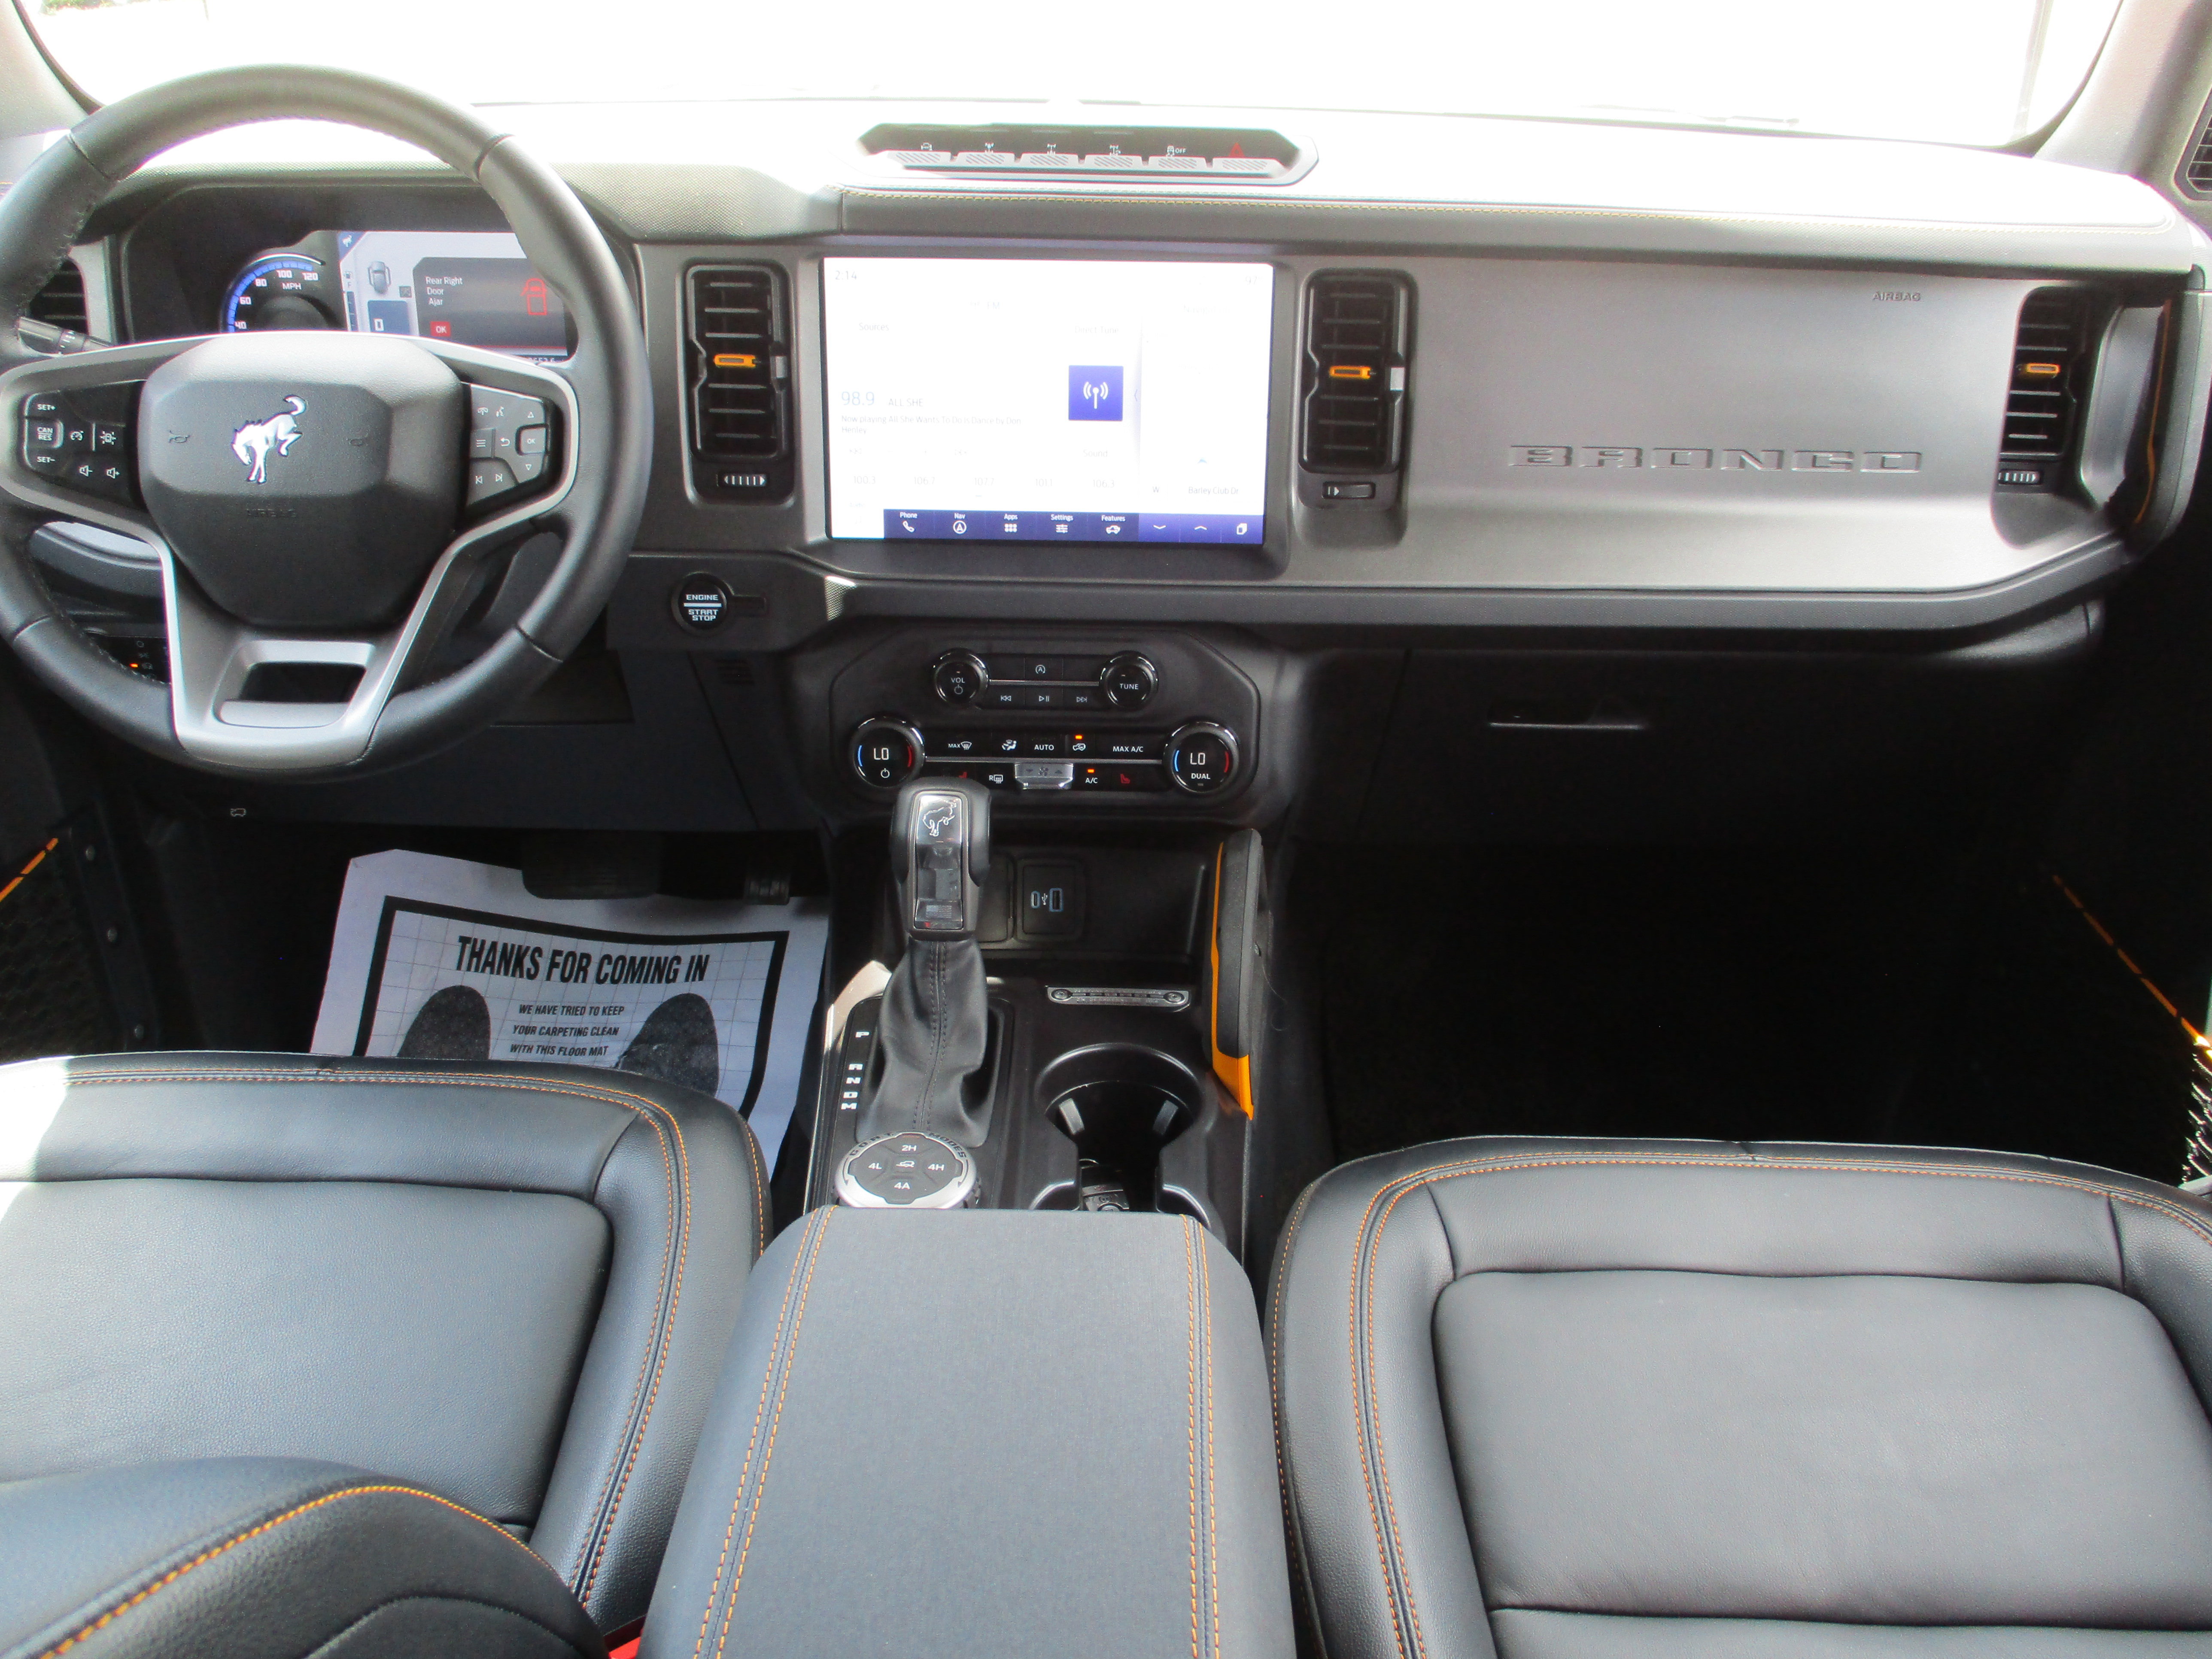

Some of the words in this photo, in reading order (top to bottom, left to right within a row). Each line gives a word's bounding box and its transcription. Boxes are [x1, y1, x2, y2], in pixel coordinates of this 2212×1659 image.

[276, 270, 292, 278] 100
[302, 272, 319, 280] 120
[835, 270, 857, 280] 2:14
[425, 276, 442, 284] Rear
[444, 276, 463, 286] Right
[427, 286, 444, 295] Door
[240, 296, 252, 305] 60
[1872, 291, 1921, 301] AIRBAG
[428, 297, 443, 307] Ajar
[235, 321, 247, 329] 40
[859, 322, 889, 331] Sources
[1075, 325, 1097, 334] Direct
[842, 391, 875, 406] 98.9
[888, 398, 904, 407] ALL
[906, 398, 924, 407] SHE
[842, 415, 858, 423] Now
[860, 415, 887, 425] playing
[916, 416, 939, 424] Wants
[972, 416, 994, 424] Dance
[996, 416, 1005, 425] by
[1006, 416, 1021, 425] Don
[842, 426, 867, 434] Henley
[1083, 449, 1108, 457] Sound
[1508, 445, 1922, 474] BRONCO
[854, 475, 876, 484] 100.3
[914, 476, 935, 485] 106.7
[974, 477, 994, 486] 107.7
[1035, 478, 1053, 487] 101.1
[1093, 479, 1115, 488] 106.3
[1188, 486, 1211, 495] Barley
[456, 936, 543, 981] THANKS
[546, 949, 592, 984] FOR
[595, 954, 682, 984] COMING
[684, 954, 711, 982] IN
[519, 1004, 534, 1015] WE
[535, 1005, 559, 1015] HAVE
[560, 1006, 586, 1016] TRIED
[589, 1006, 600, 1016] TO
[601, 1006, 625, 1016] KEEP
[514, 1024, 538, 1036] YOUR
[538, 1026, 589, 1037] CARPETING
[590, 1026, 620, 1036] CLEAN
[510, 1044, 534, 1053] WITH
[536, 1045, 557, 1055] THIS
[558, 1046, 587, 1056] FLOOR
[588, 1045, 609, 1056] MAT
